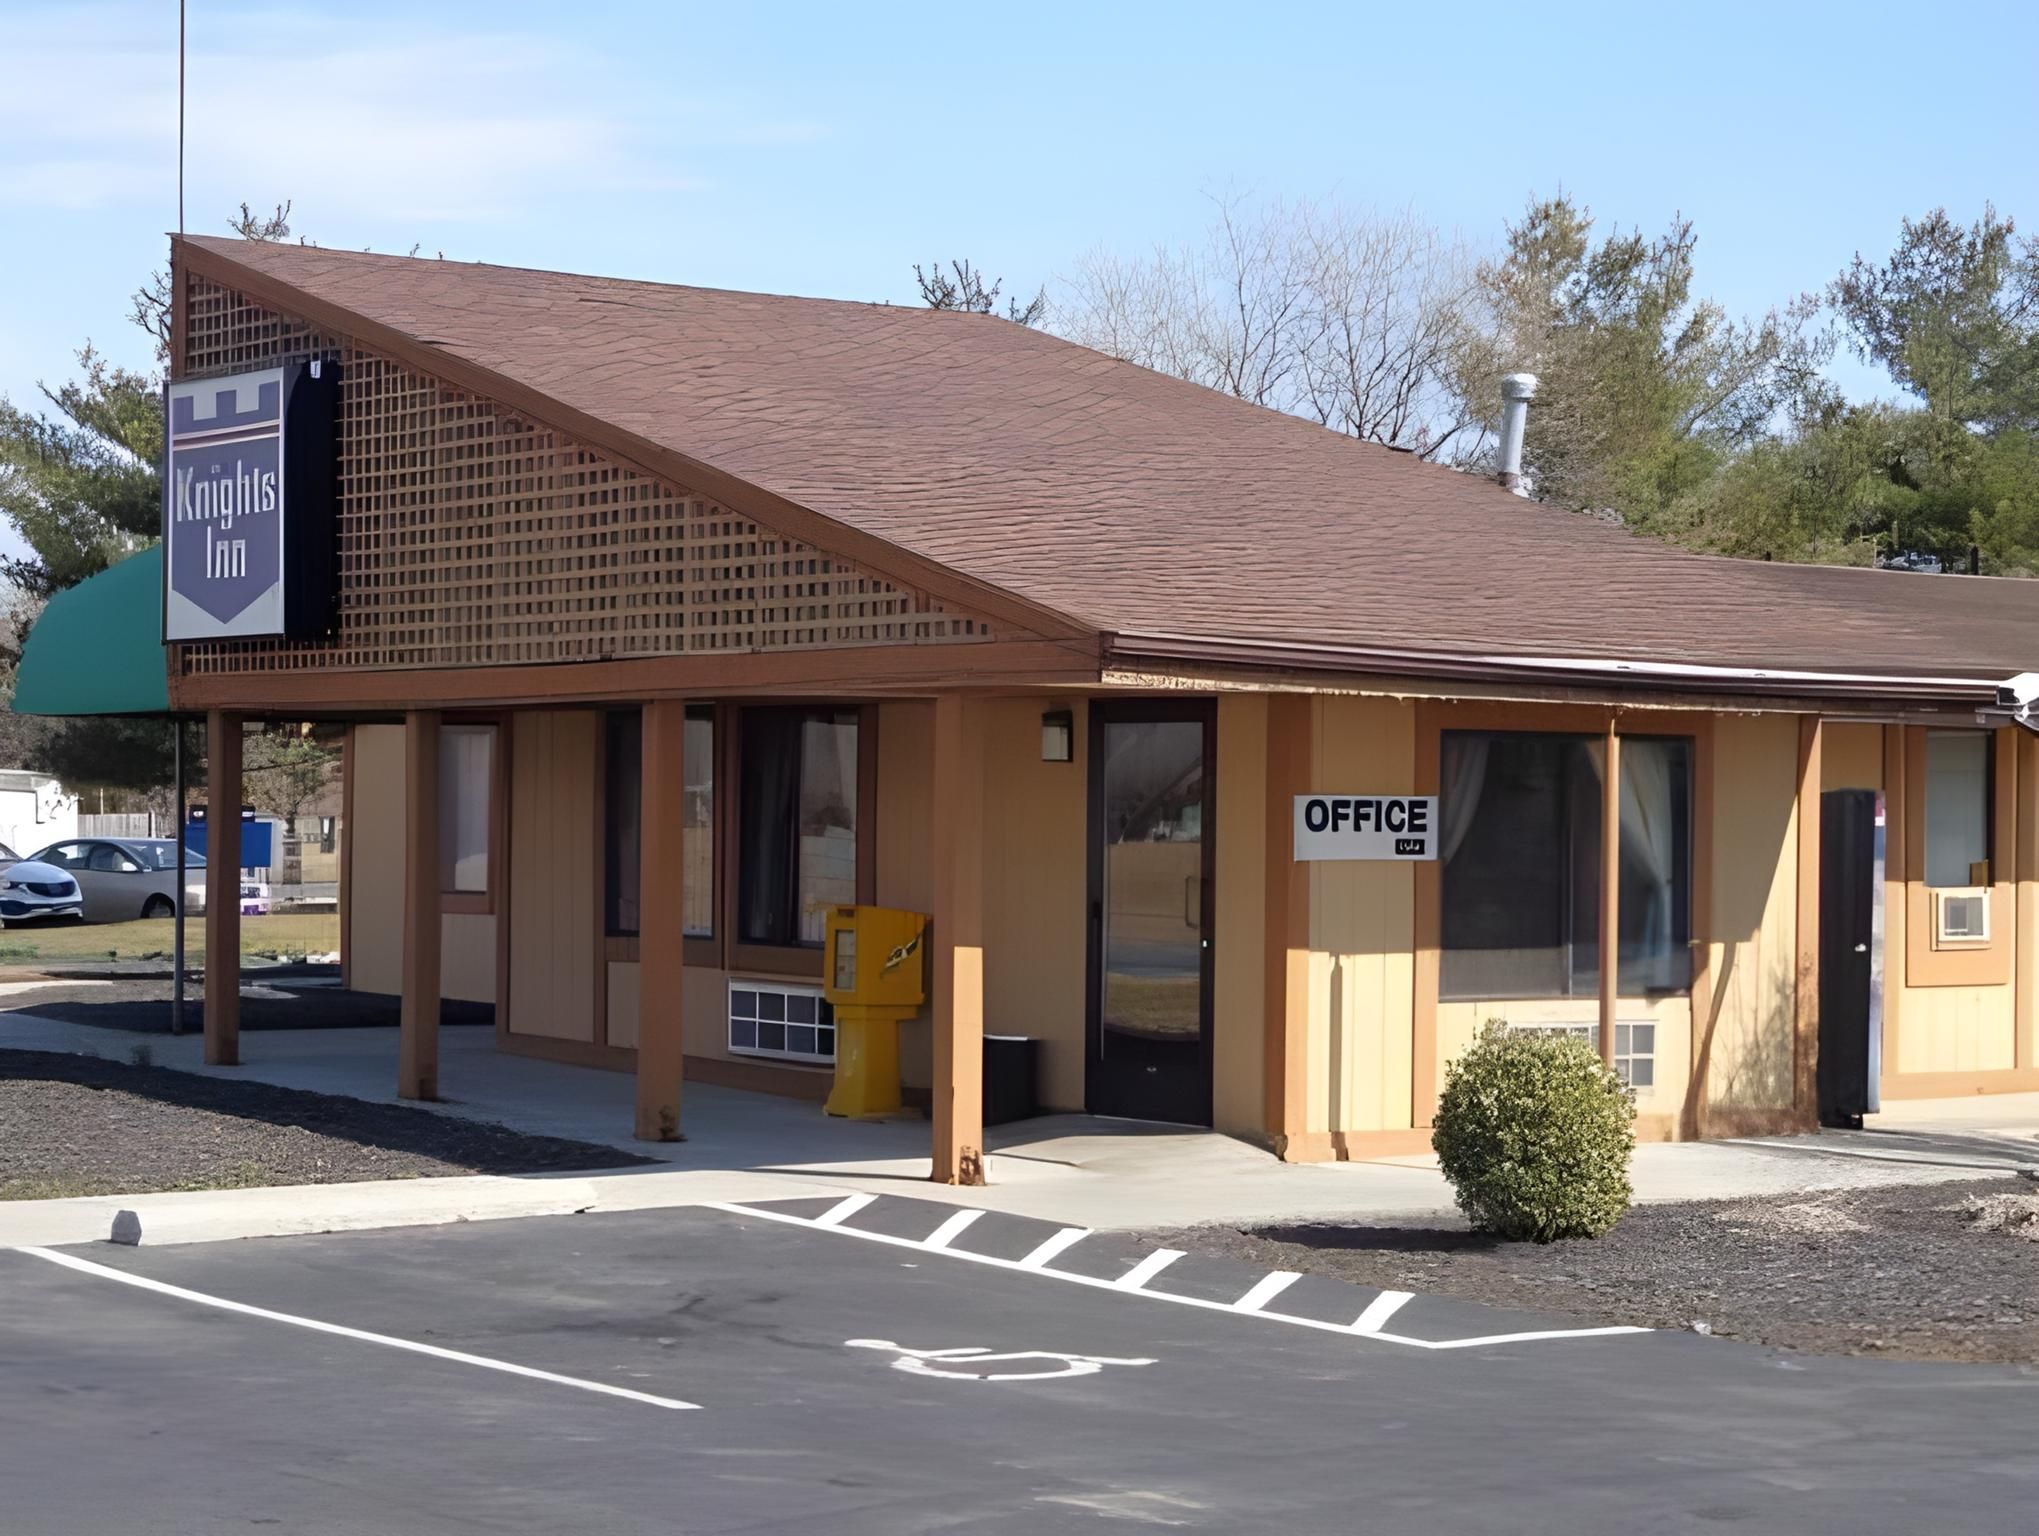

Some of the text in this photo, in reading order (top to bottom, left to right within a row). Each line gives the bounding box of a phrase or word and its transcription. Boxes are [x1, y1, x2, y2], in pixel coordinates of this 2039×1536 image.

[176, 459, 276, 530] Knights
[206, 525, 246, 579] Inn
[1305, 799, 1428, 832] OFFICE
